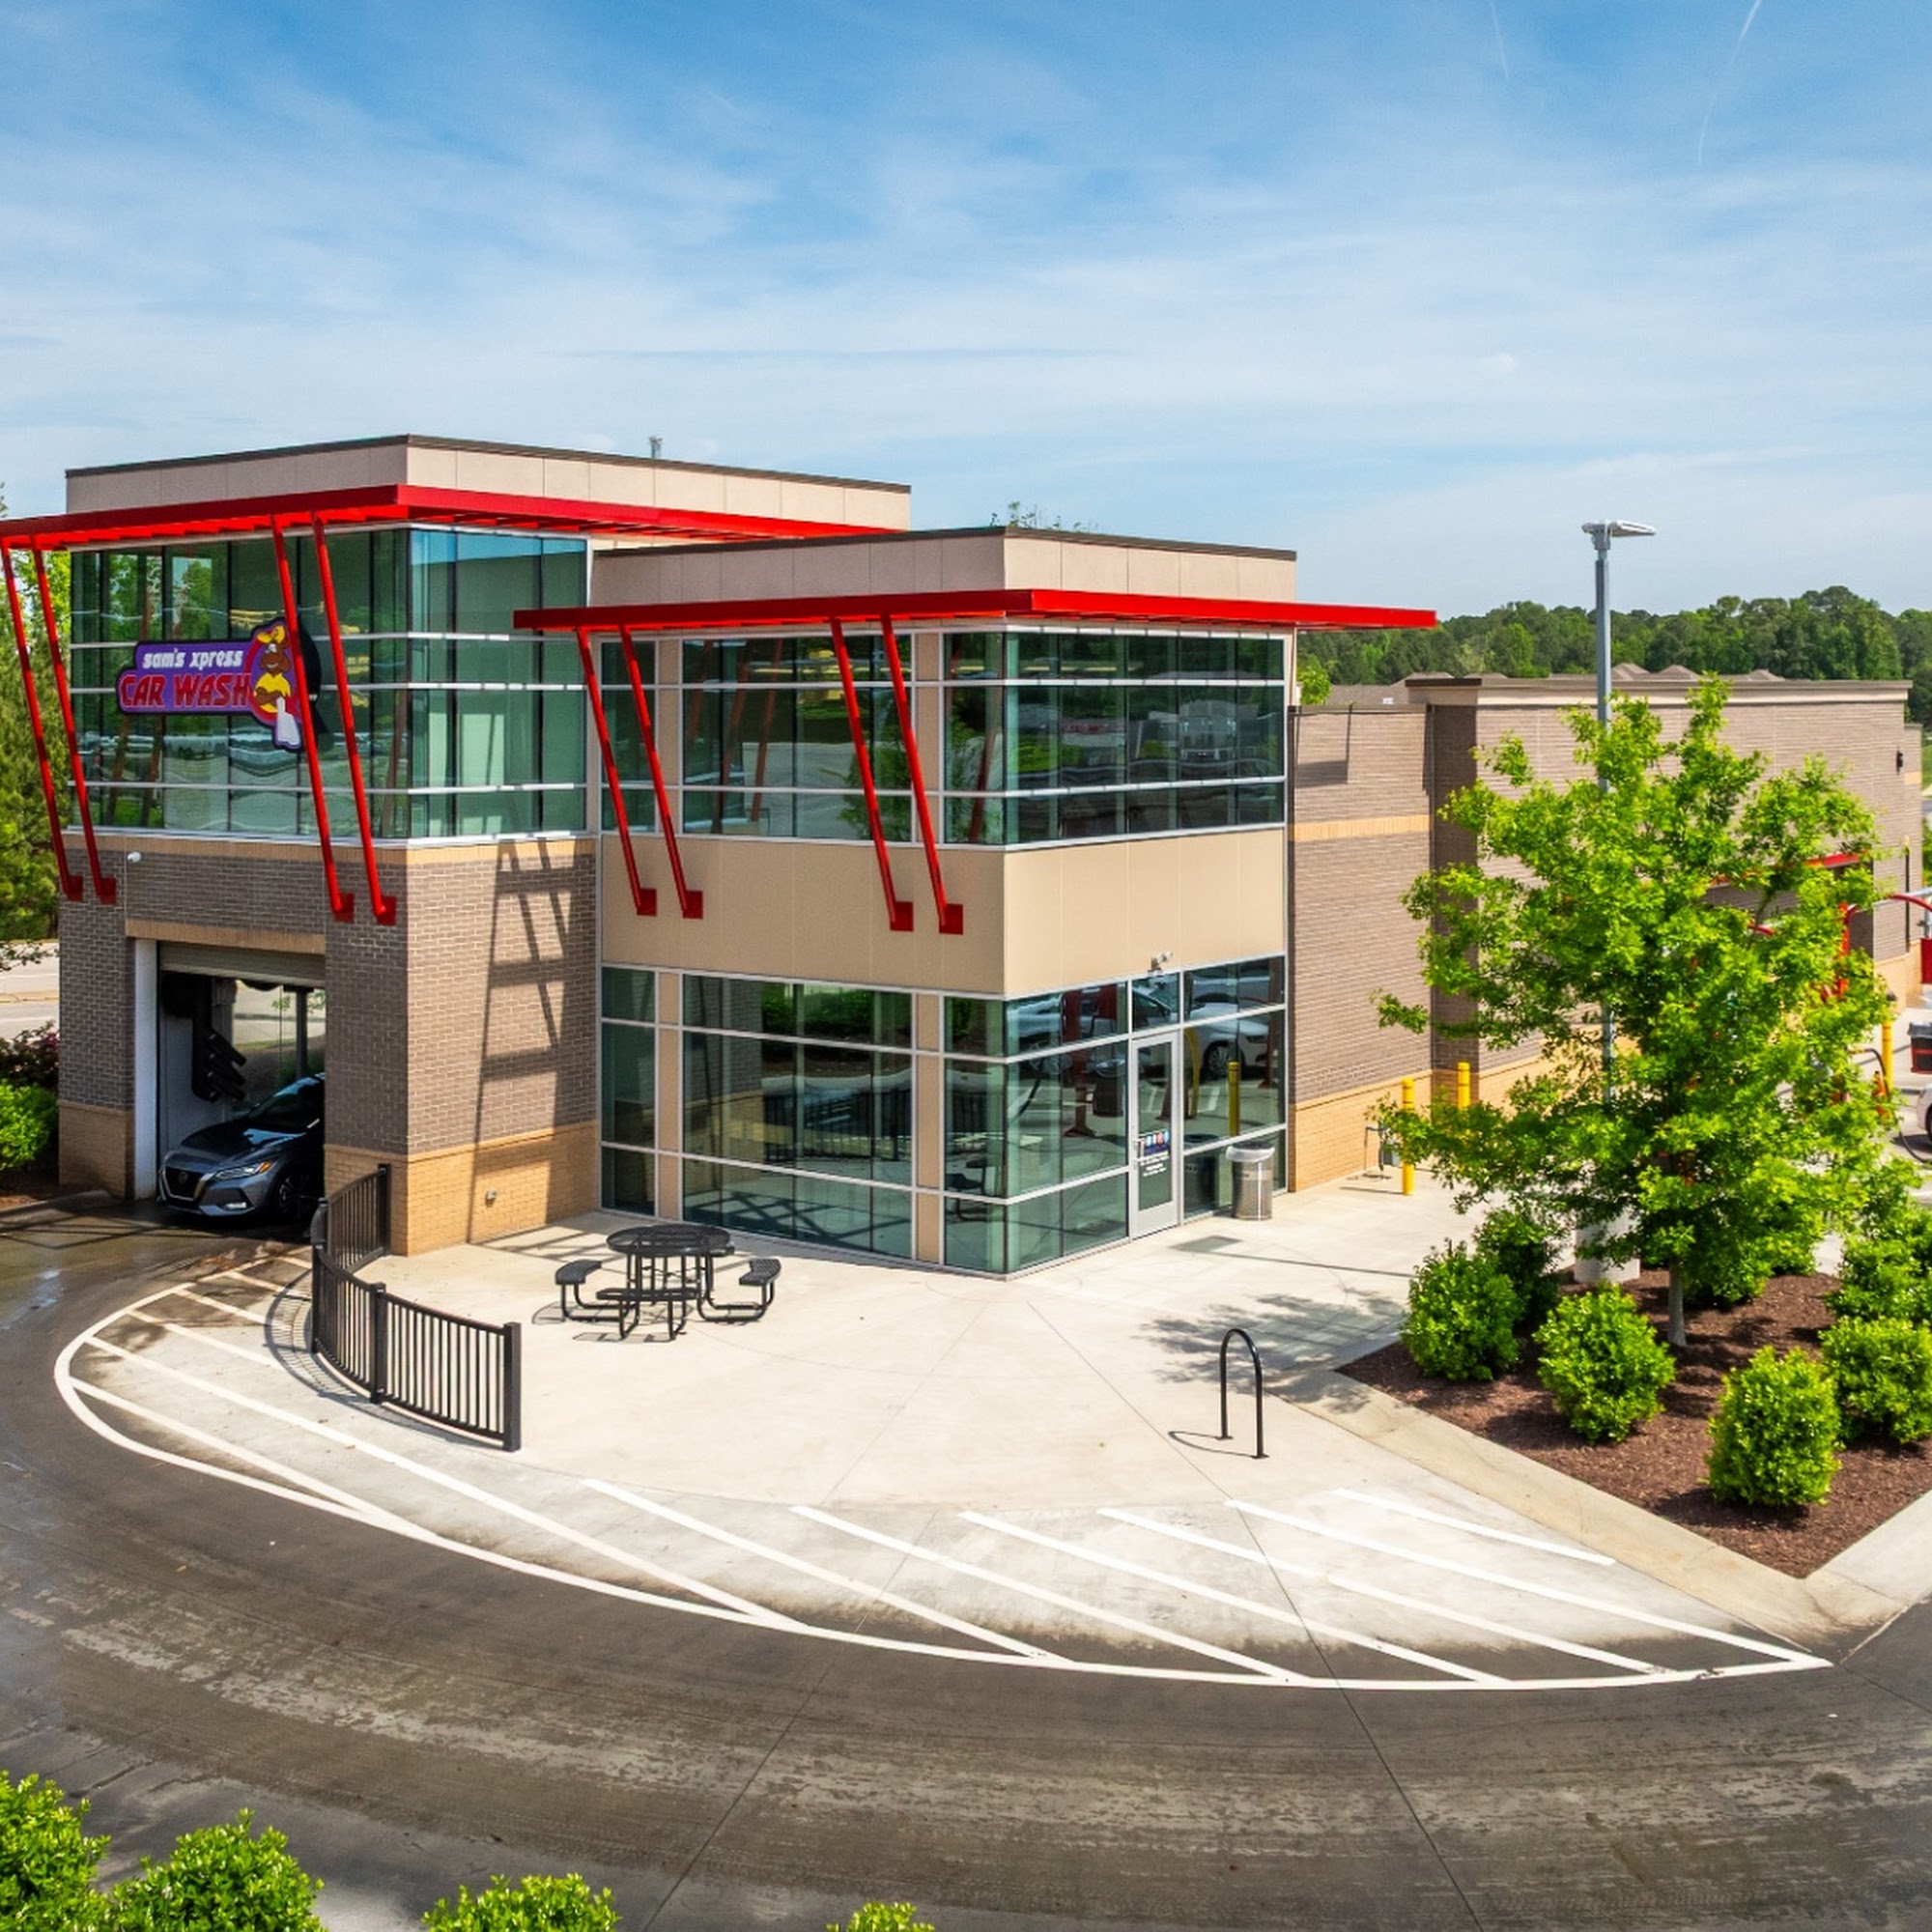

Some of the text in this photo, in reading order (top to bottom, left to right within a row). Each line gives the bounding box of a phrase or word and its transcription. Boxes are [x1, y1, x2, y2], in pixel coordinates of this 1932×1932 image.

[142, 647, 243, 670] sam's xpress
[120, 673, 252, 708] CAR WASH
